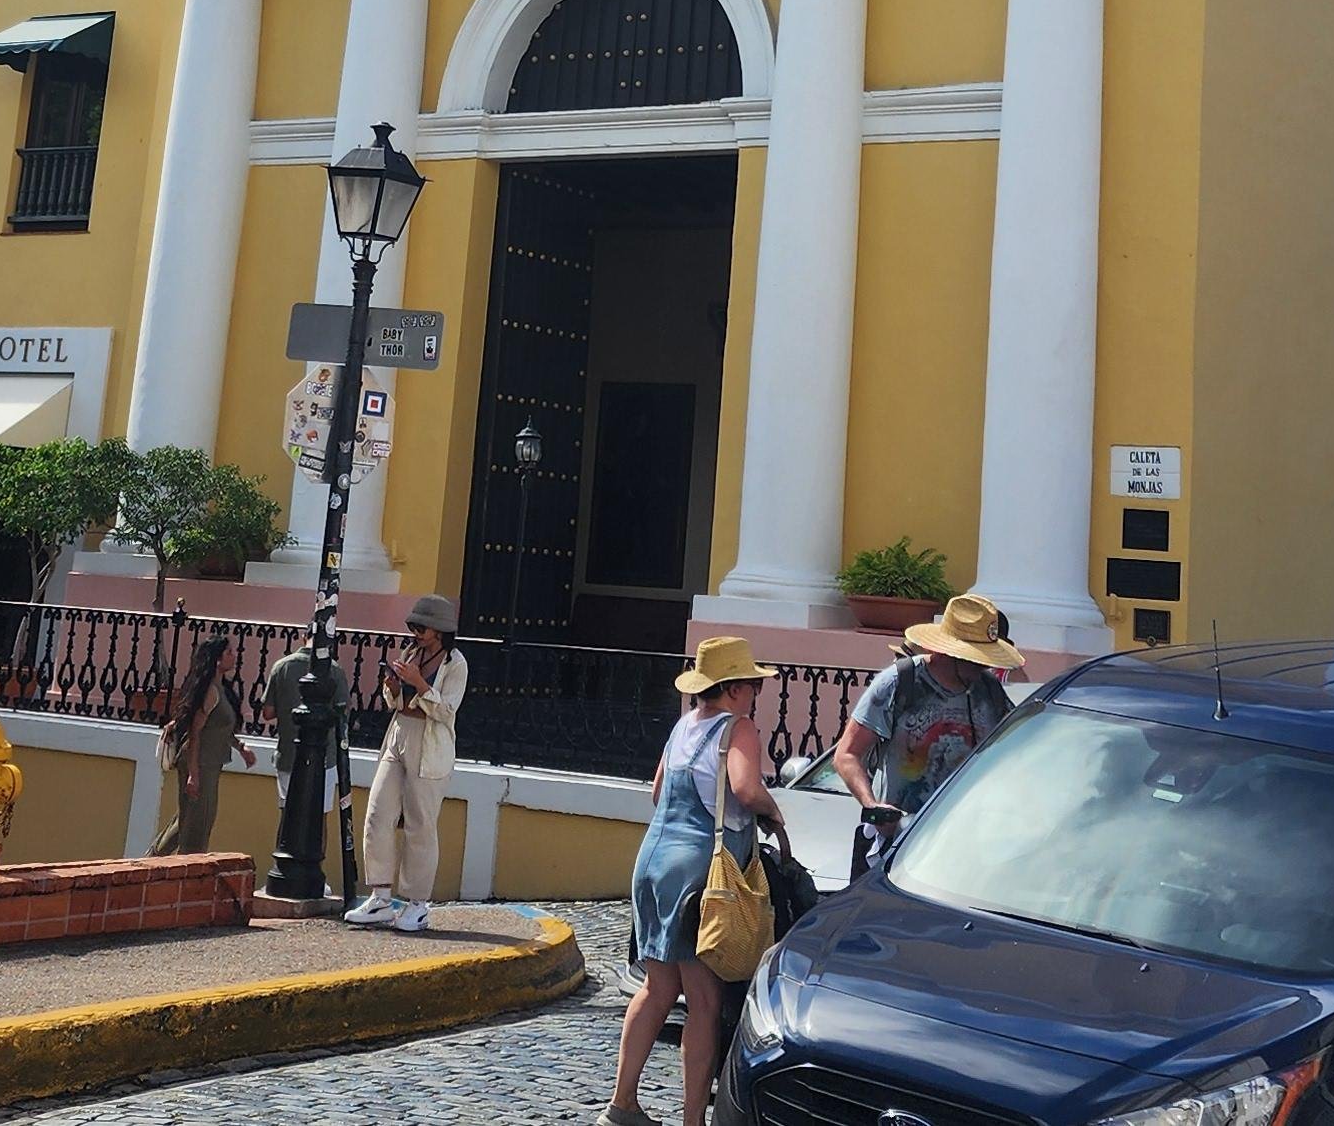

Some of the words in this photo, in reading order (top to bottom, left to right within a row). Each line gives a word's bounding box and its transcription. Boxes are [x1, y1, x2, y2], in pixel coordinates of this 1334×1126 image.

[382, 328, 404, 341] BABY
[381, 344, 404, 356] THOR
[1129, 451, 1161, 464] CALETA
[1132, 468, 1142, 476] DE
[1145, 468, 1161, 476] LAS
[1127, 480, 1163, 494] MONJAS
